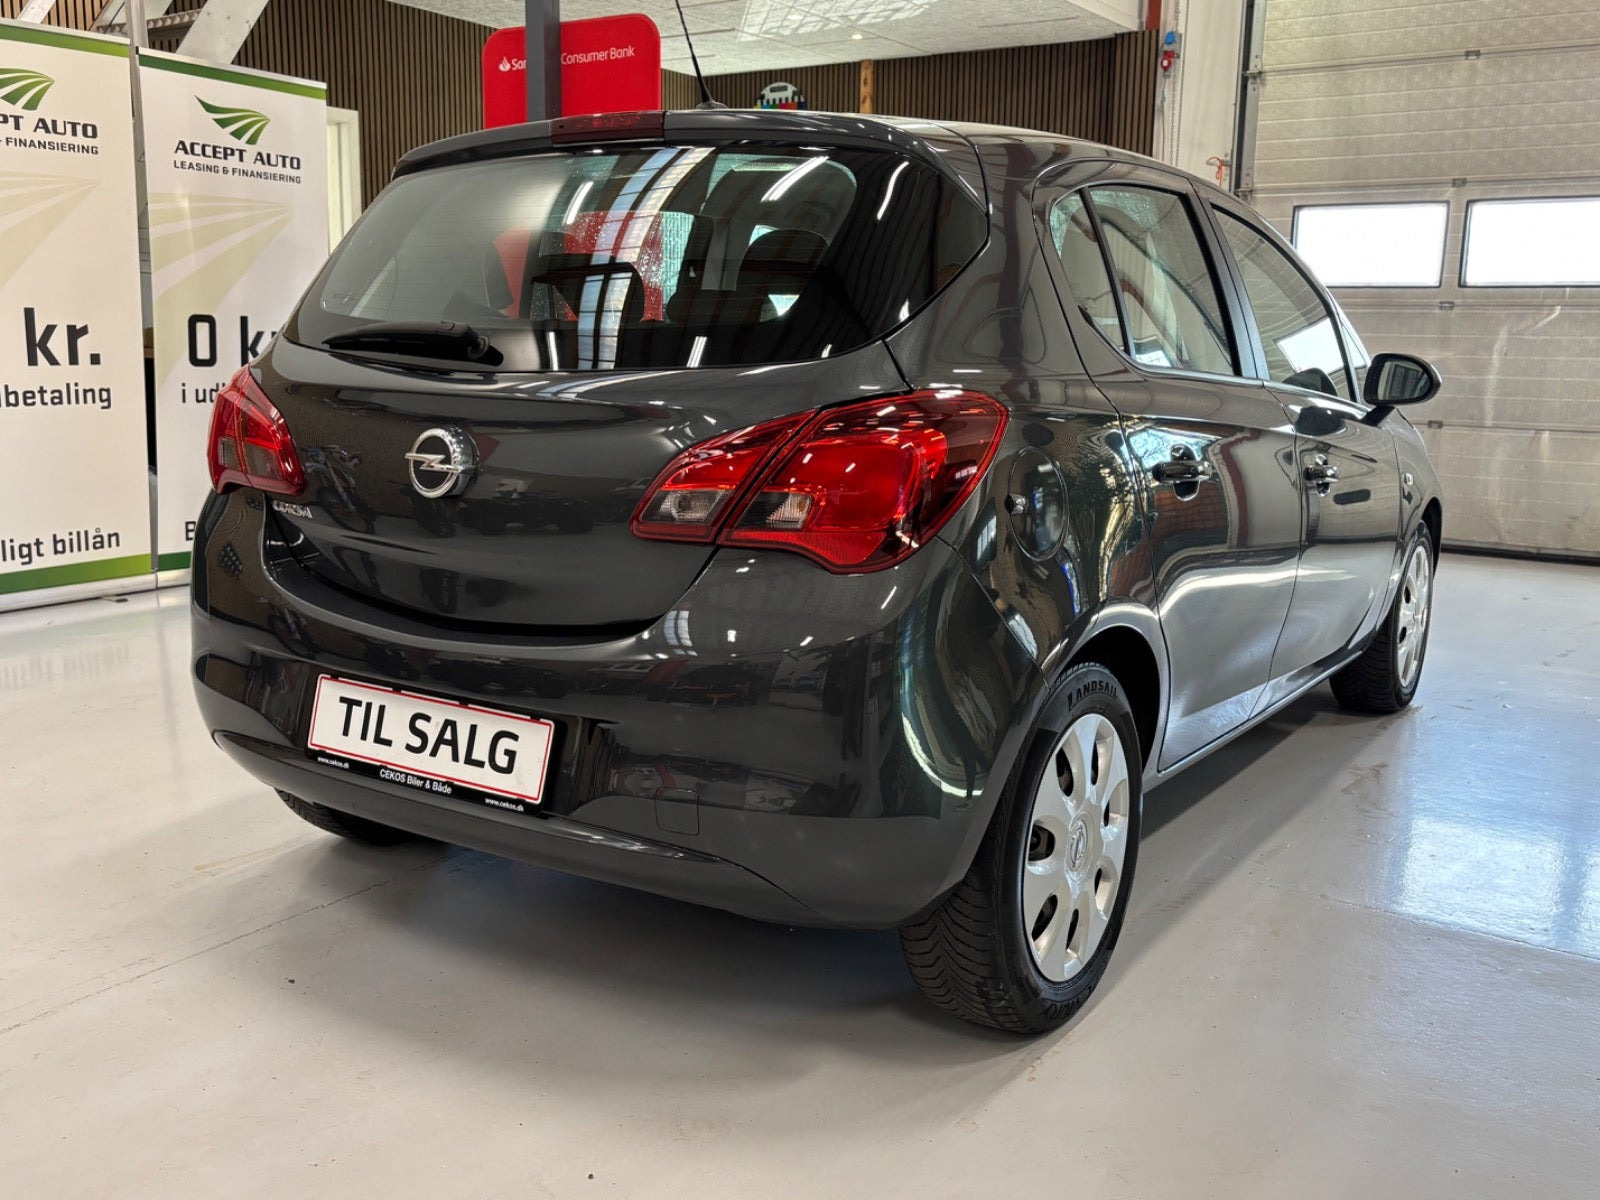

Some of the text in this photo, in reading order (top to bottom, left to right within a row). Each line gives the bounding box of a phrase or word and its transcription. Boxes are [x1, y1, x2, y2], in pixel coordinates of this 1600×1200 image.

[560, 49, 608, 65] Consumer
[609, 45, 635, 60] Bank
[33, 117, 98, 139] AUTO
[5, 137, 99, 155] FINANSIERING
[174, 140, 301, 170] ACCEPT AUTO
[174, 160, 302, 185] LEASING & FINANSIERING
[24, 307, 101, 367] kr.
[240, 315, 278, 367] k
[0, 382, 111, 410] betaling
[181, 382, 226, 403] i ud
[52, 527, 120, 555] billån
[1067, 680, 1118, 712] LANDSAIL
[339, 696, 519, 775] TIL SALG
[380, 768, 406, 783] CEKOS
[425, 780, 430, 789] &
